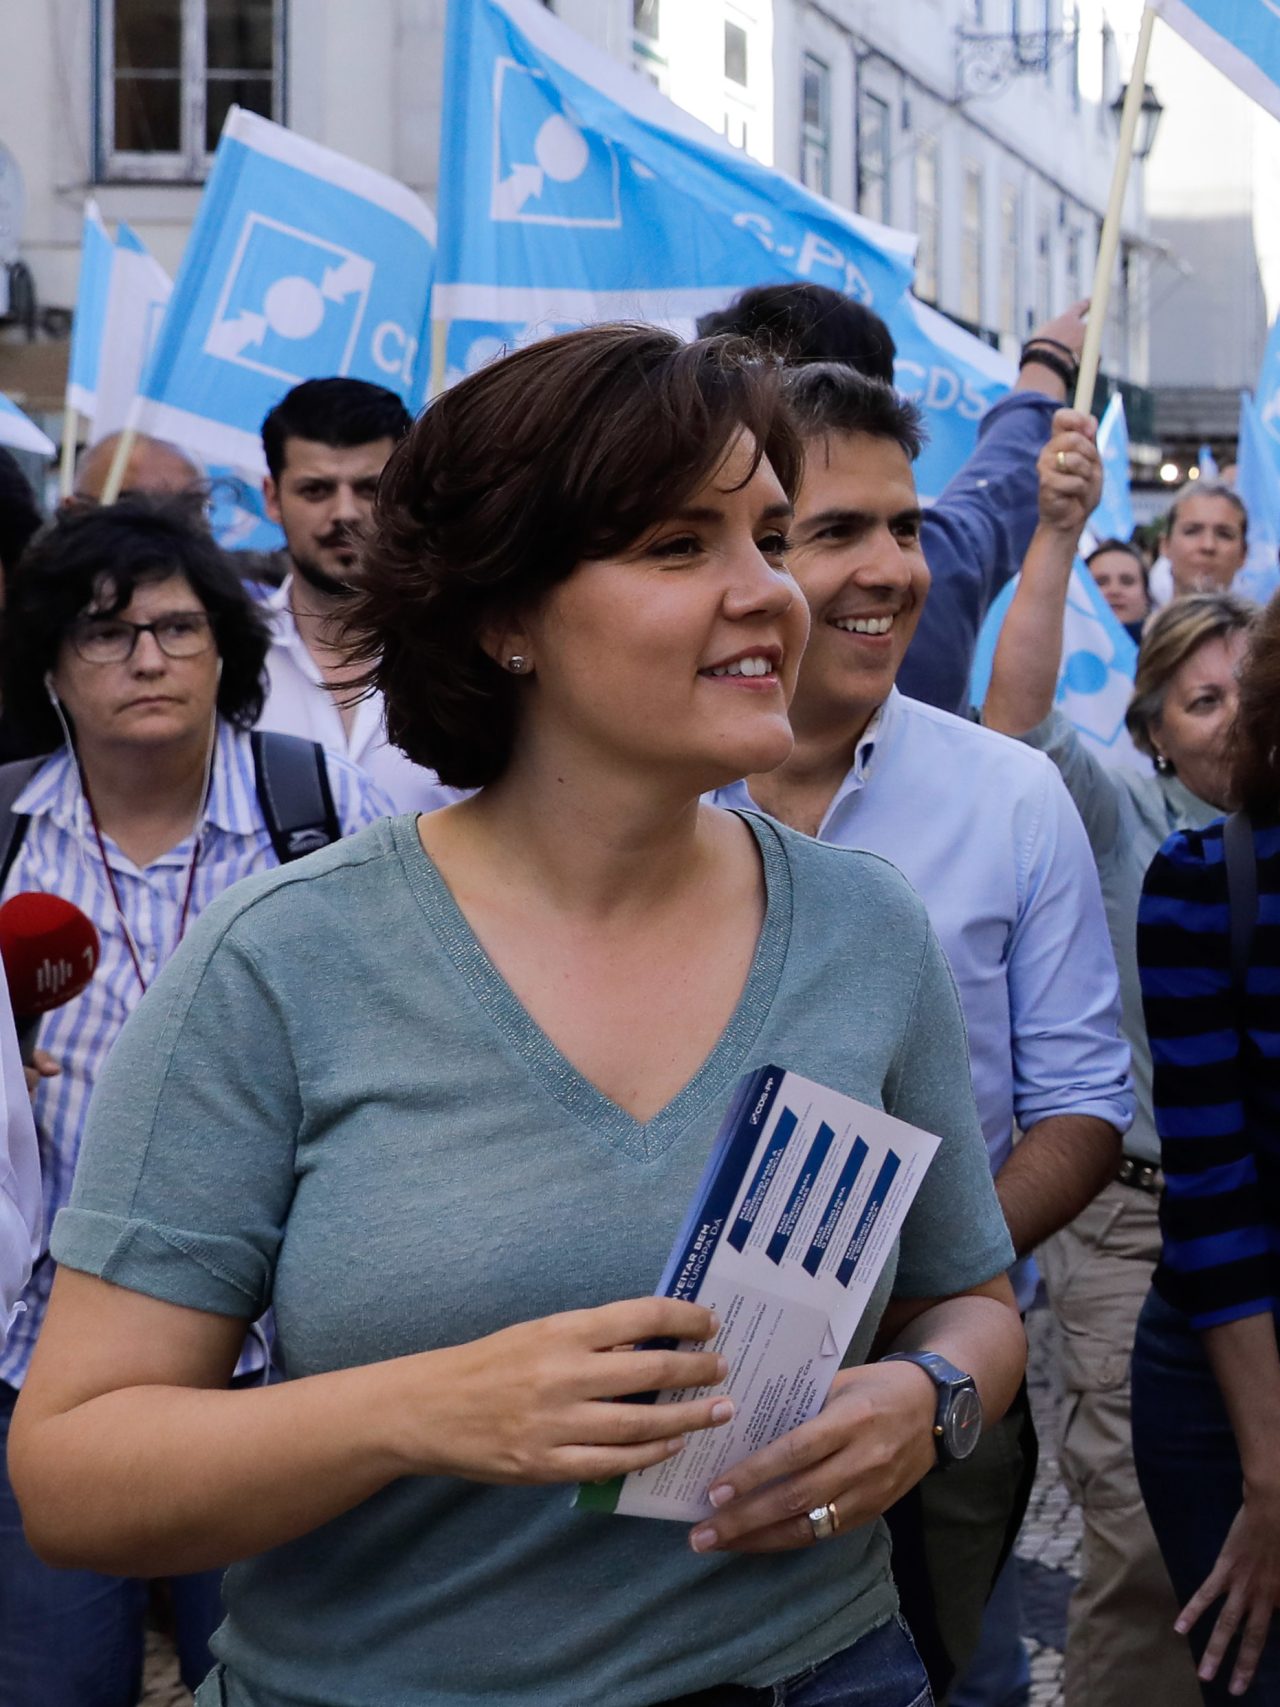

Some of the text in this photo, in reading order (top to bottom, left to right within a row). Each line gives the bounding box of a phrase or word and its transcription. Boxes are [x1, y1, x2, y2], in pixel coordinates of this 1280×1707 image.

[760, 1157, 774, 1180] PARA
[738, 1197, 751, 1219] MAIS
[670, 1222, 710, 1300] VEITAR BEM
[685, 1237, 714, 1289] EUROPA
